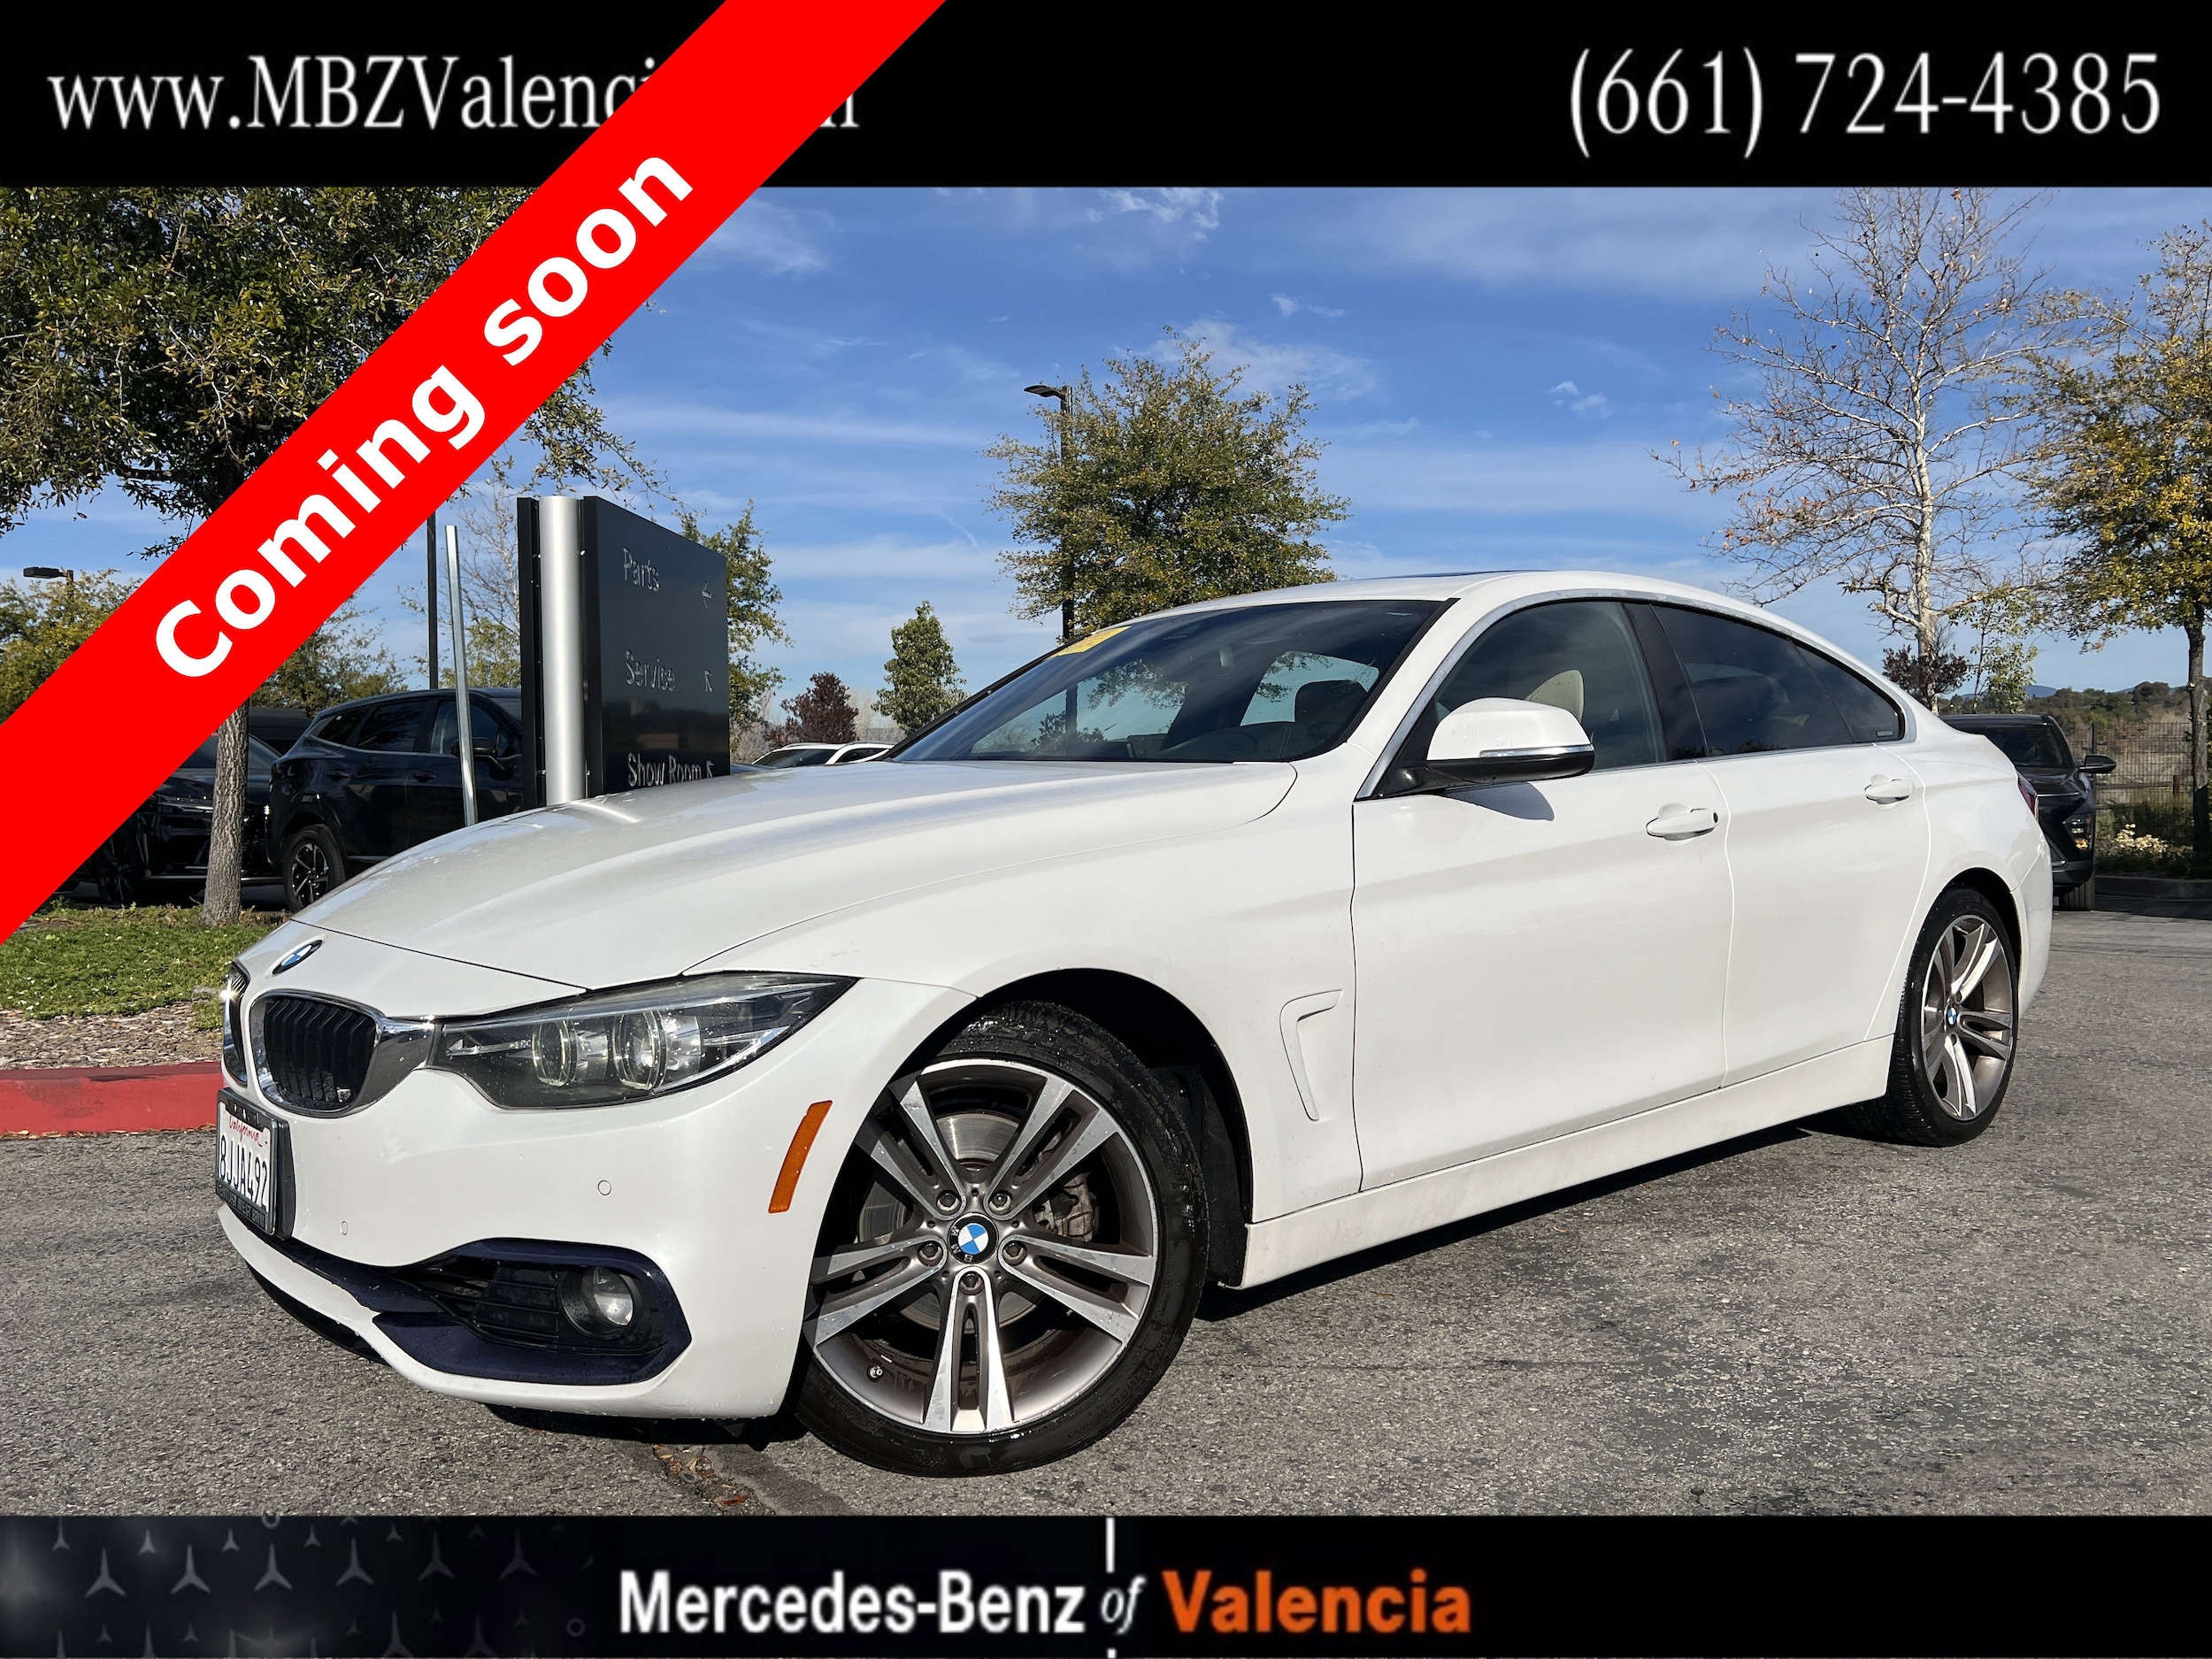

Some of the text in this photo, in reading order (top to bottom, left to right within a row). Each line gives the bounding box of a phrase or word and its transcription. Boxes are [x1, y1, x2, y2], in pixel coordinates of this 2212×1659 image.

[623, 547, 660, 592] Parts
[626, 649, 675, 692] Service
[627, 752, 702, 787] Show Room
[219, 1134, 267, 1211] 8JJA492
[950, 1225, 973, 1263] BMW
